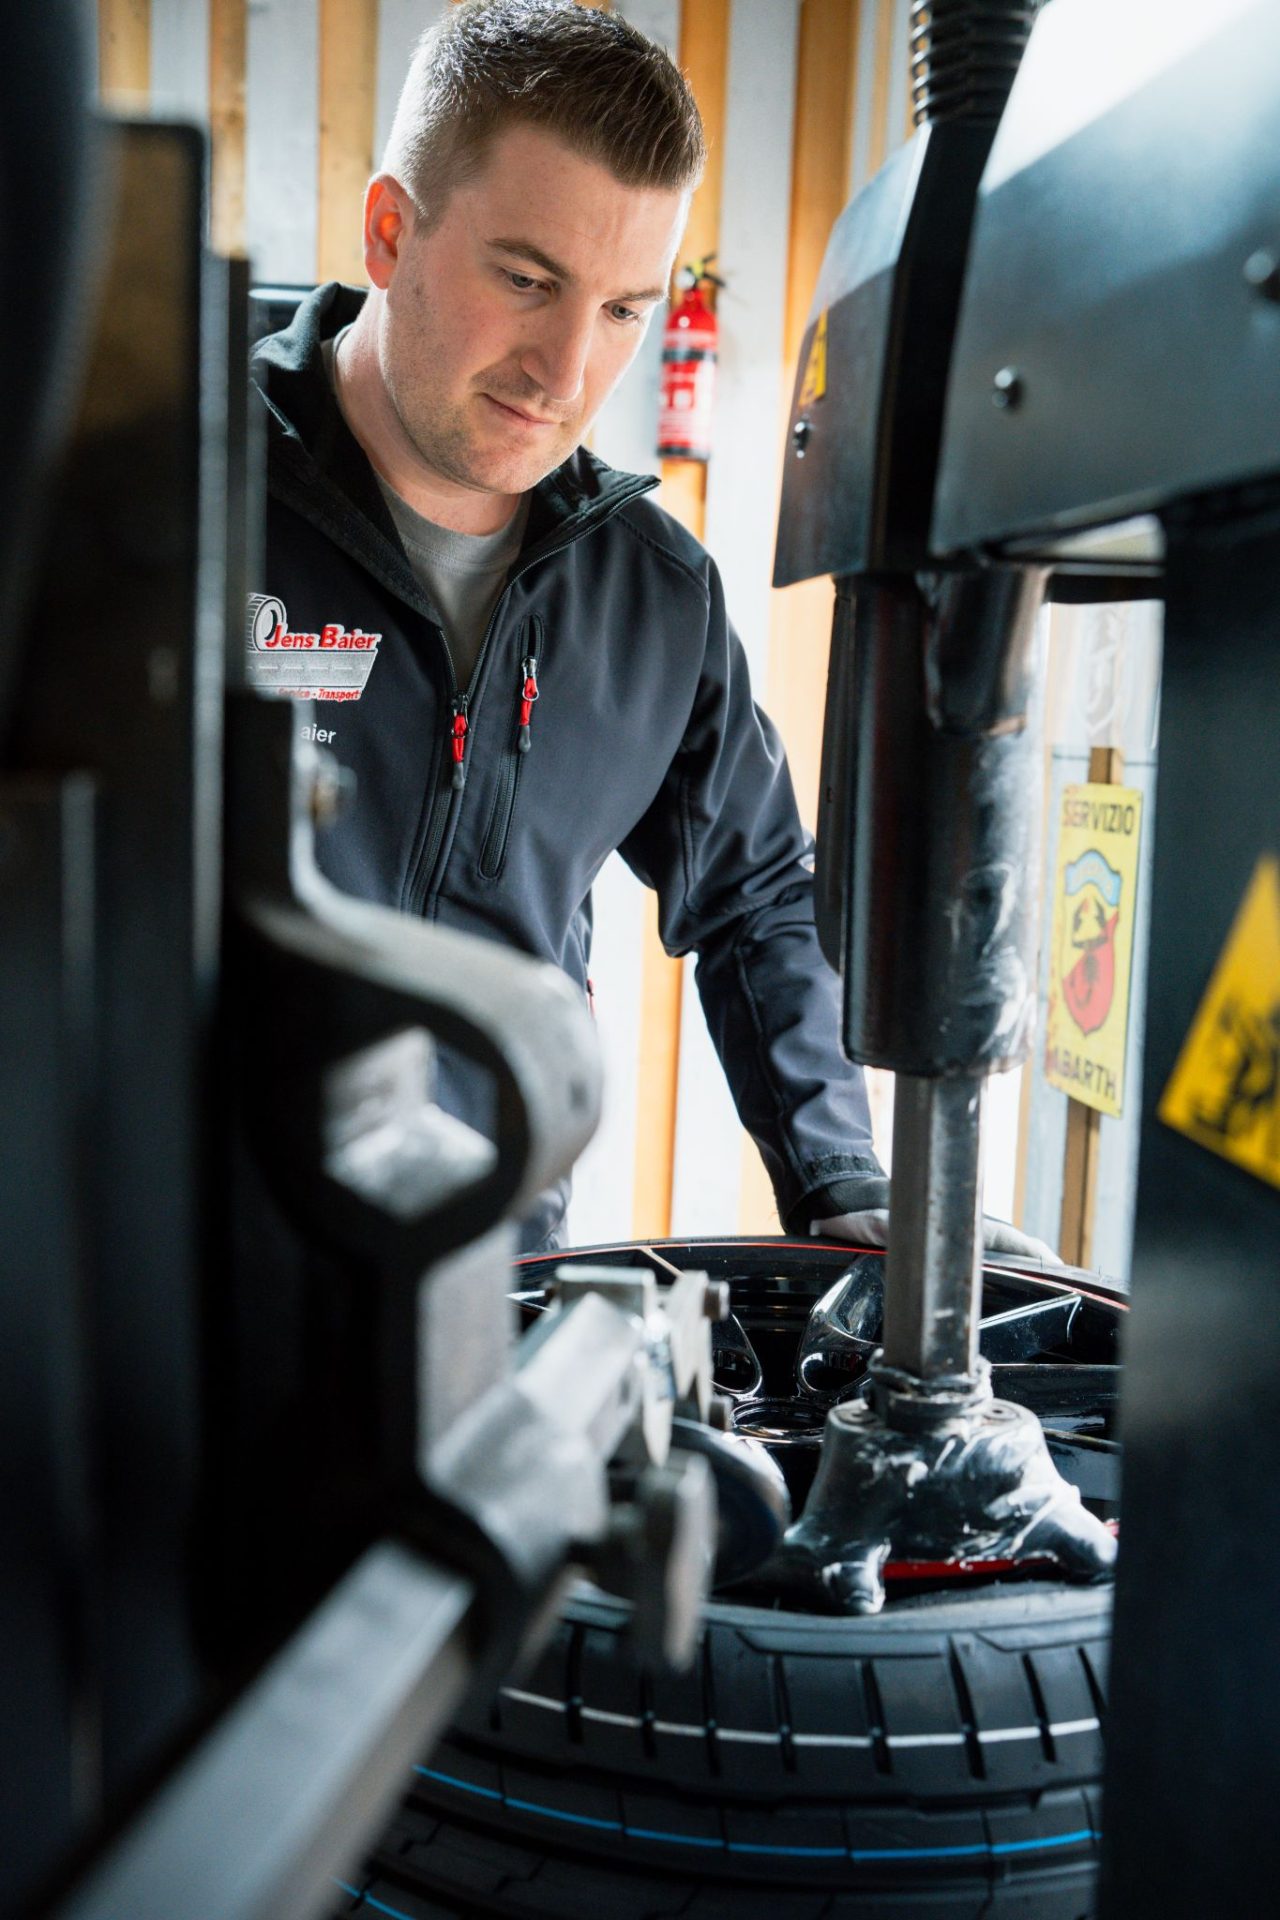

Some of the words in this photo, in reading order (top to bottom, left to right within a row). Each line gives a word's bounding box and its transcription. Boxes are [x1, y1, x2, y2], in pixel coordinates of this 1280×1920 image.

[265, 624, 315, 648] Jens
[319, 626, 376, 649] Baier
[318, 688, 361, 702] Transport
[300, 723, 337, 744] aier
[1063, 799, 1135, 836] SERVIZIO
[1045, 1045, 1116, 1101] ABARTH
